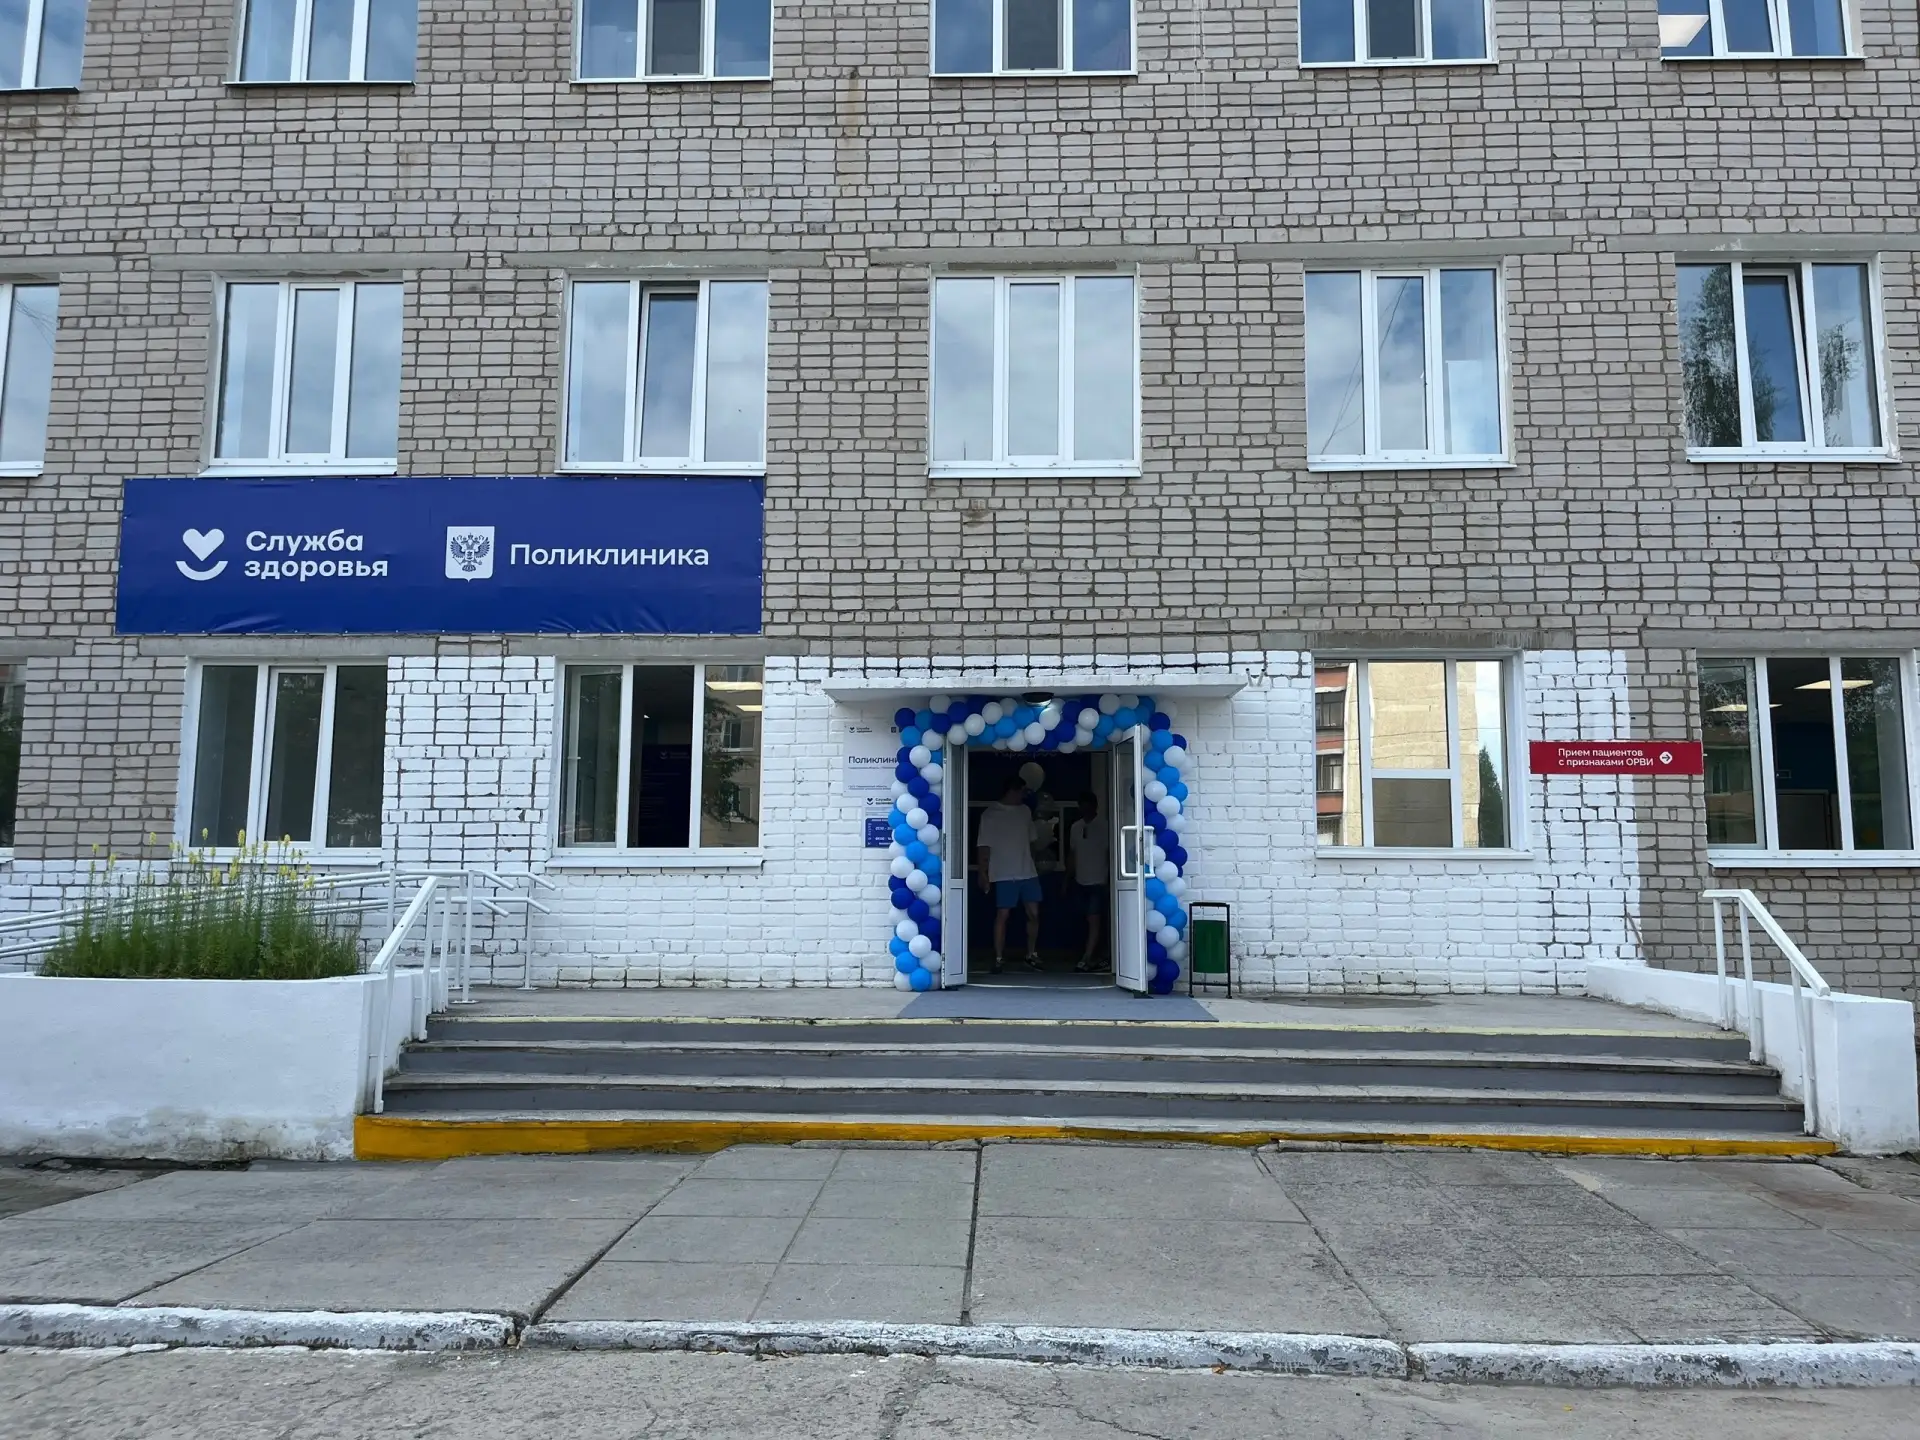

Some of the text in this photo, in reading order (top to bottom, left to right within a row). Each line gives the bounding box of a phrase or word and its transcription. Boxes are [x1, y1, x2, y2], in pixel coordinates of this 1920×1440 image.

[246, 529, 364, 556] Служба
[510, 543, 709, 566] Поликлиника
[244, 558, 388, 581] здоровья
[1558, 748, 1643, 758] Прием пациентов
[1566, 758, 1624, 768] признаками
[1626, 758, 1653, 766] ОРВИ
